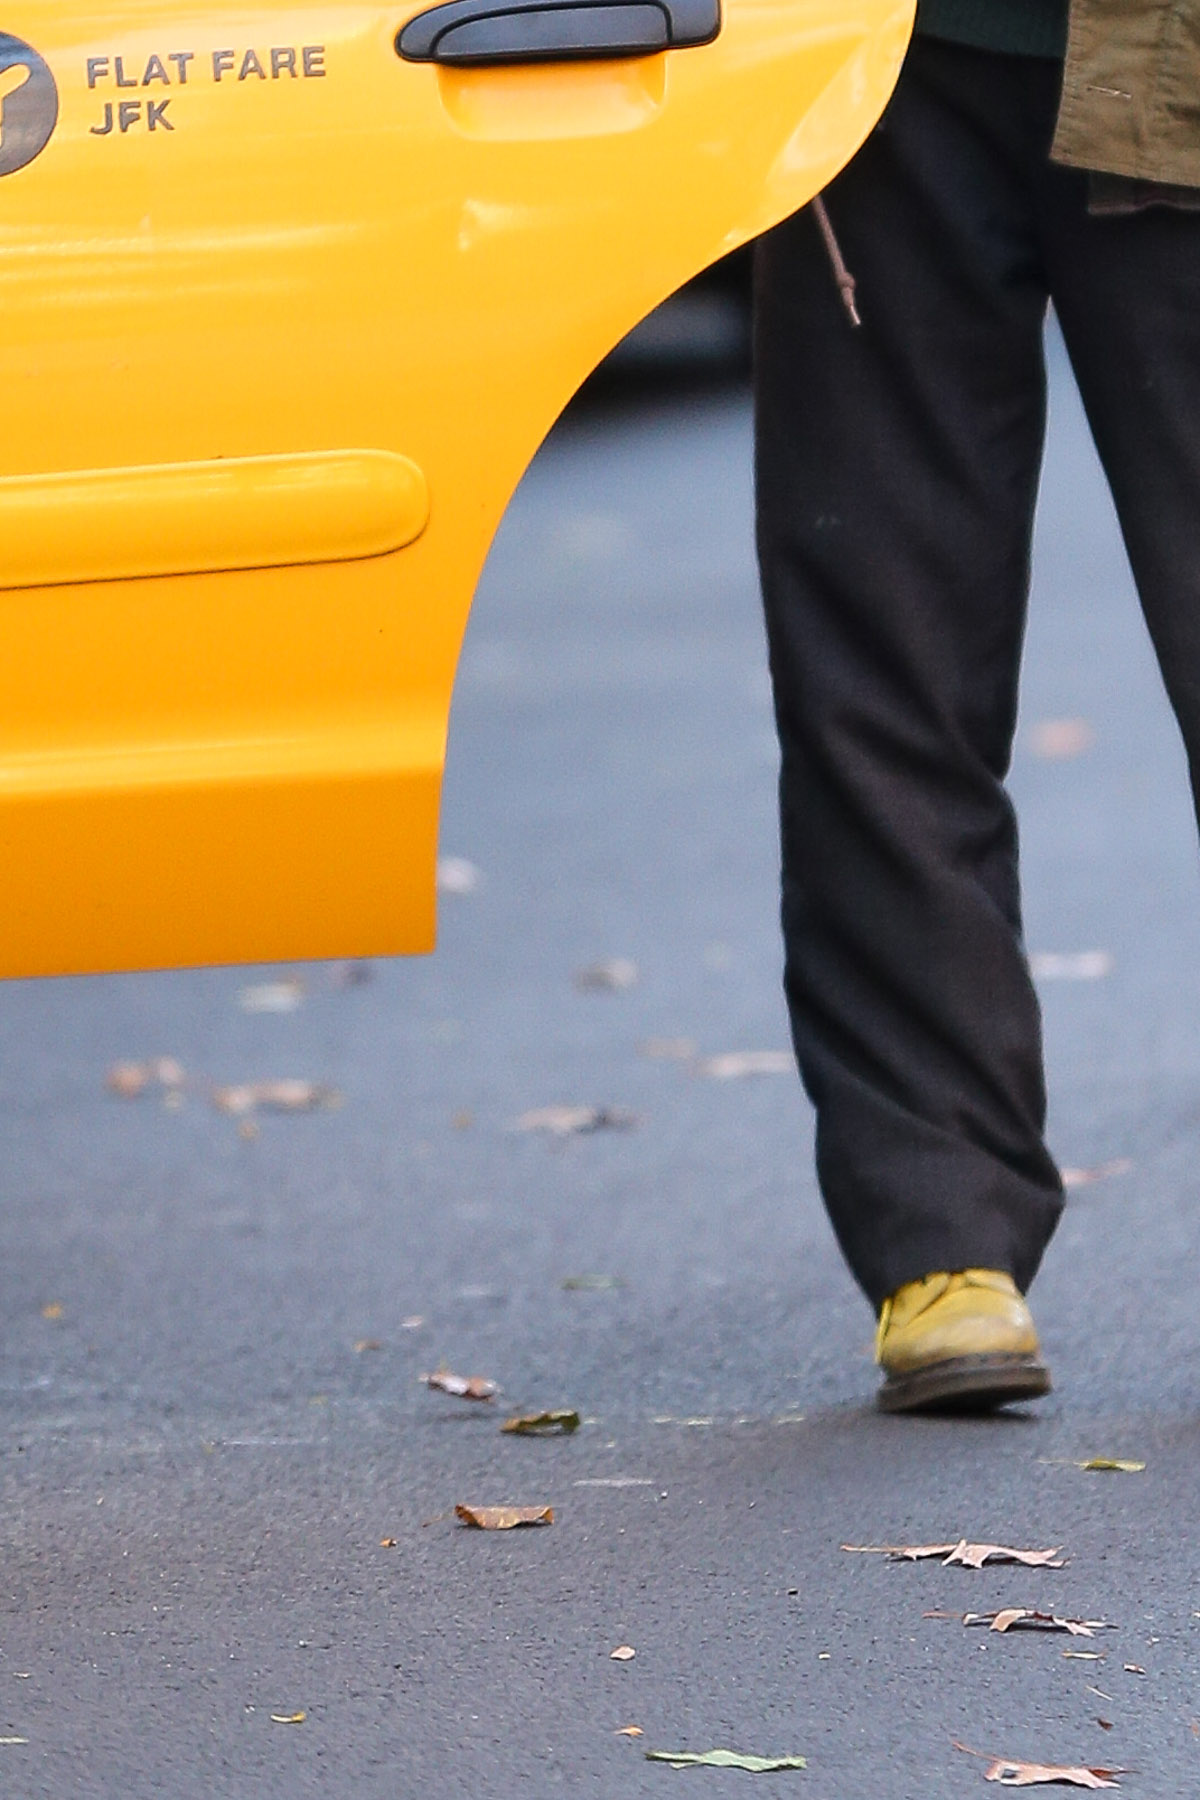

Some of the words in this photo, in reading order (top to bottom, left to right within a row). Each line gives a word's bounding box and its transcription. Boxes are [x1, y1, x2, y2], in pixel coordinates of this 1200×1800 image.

[87, 53, 194, 88] FLAT
[212, 46, 326, 82] FARE
[89, 99, 174, 135] JFK
